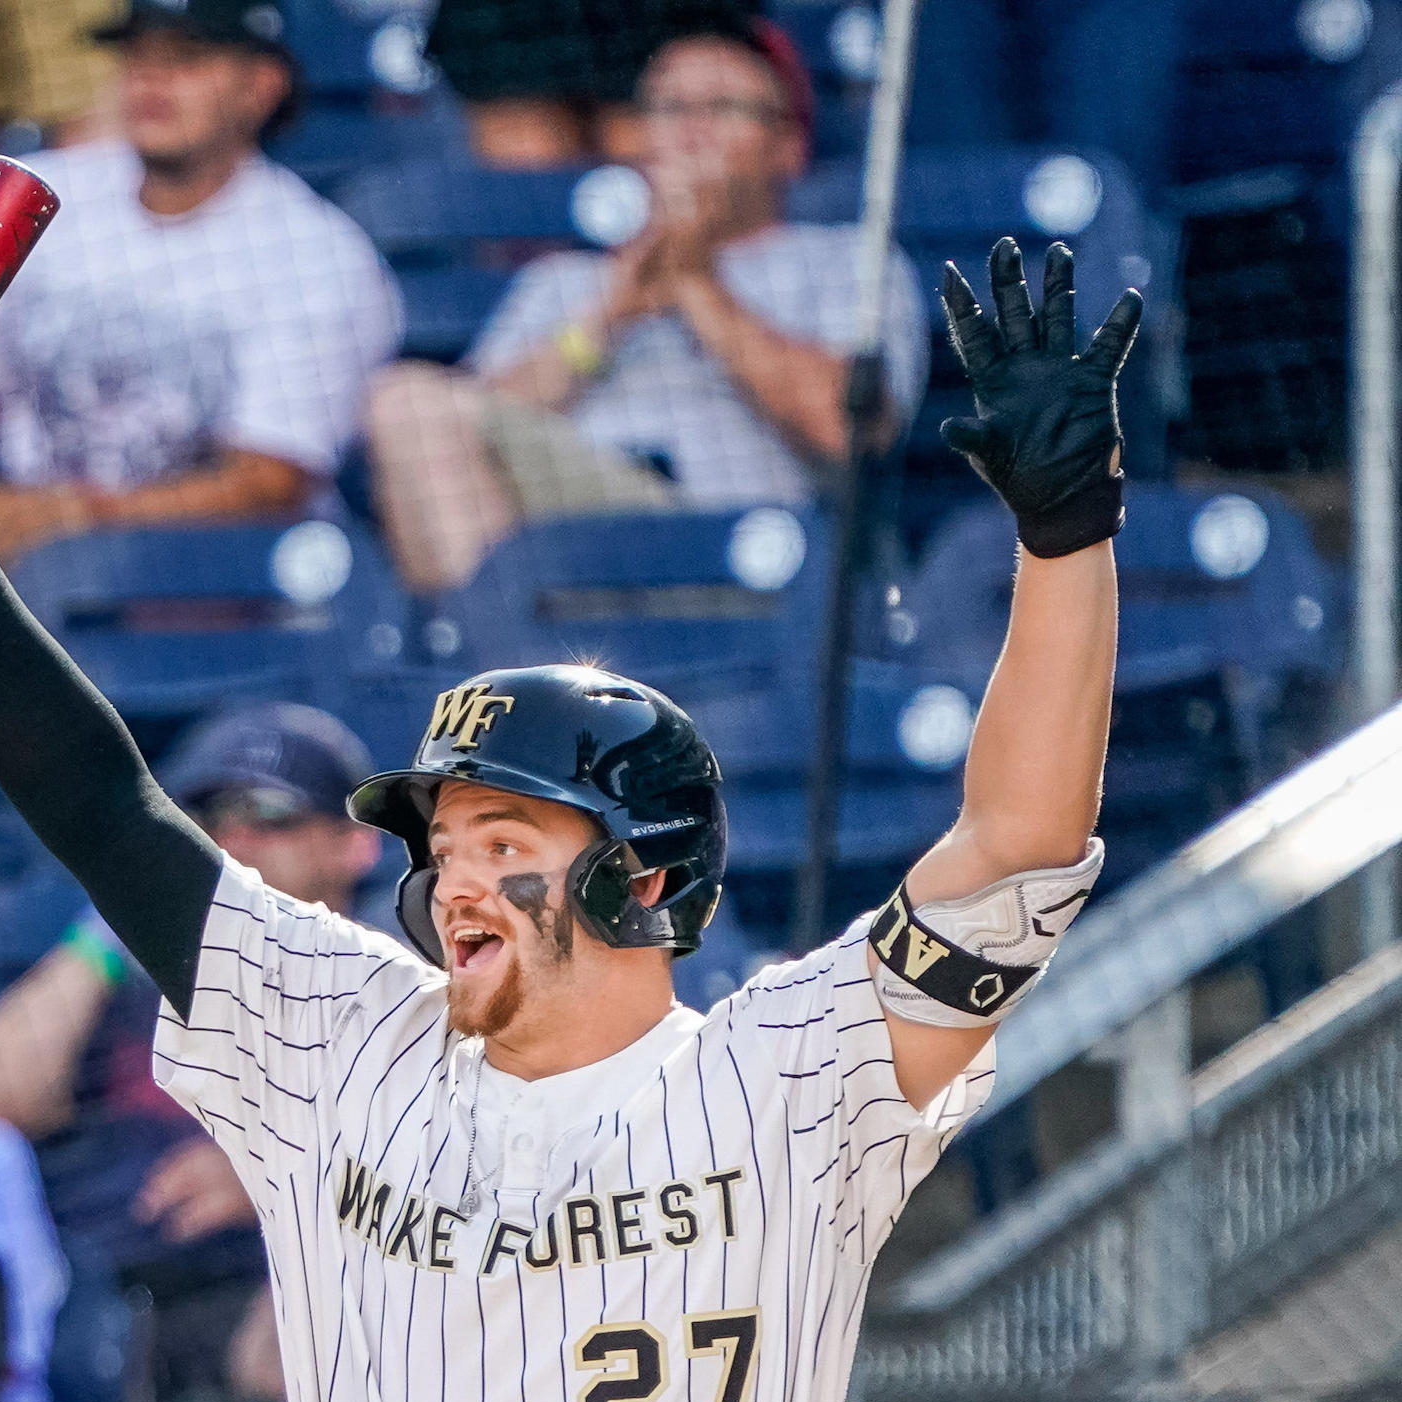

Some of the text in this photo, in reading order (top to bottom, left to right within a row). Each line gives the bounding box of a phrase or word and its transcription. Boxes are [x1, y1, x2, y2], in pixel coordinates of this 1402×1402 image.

[429, 683, 516, 750] WF
[337, 1155, 747, 1278] WAKE FOREST
